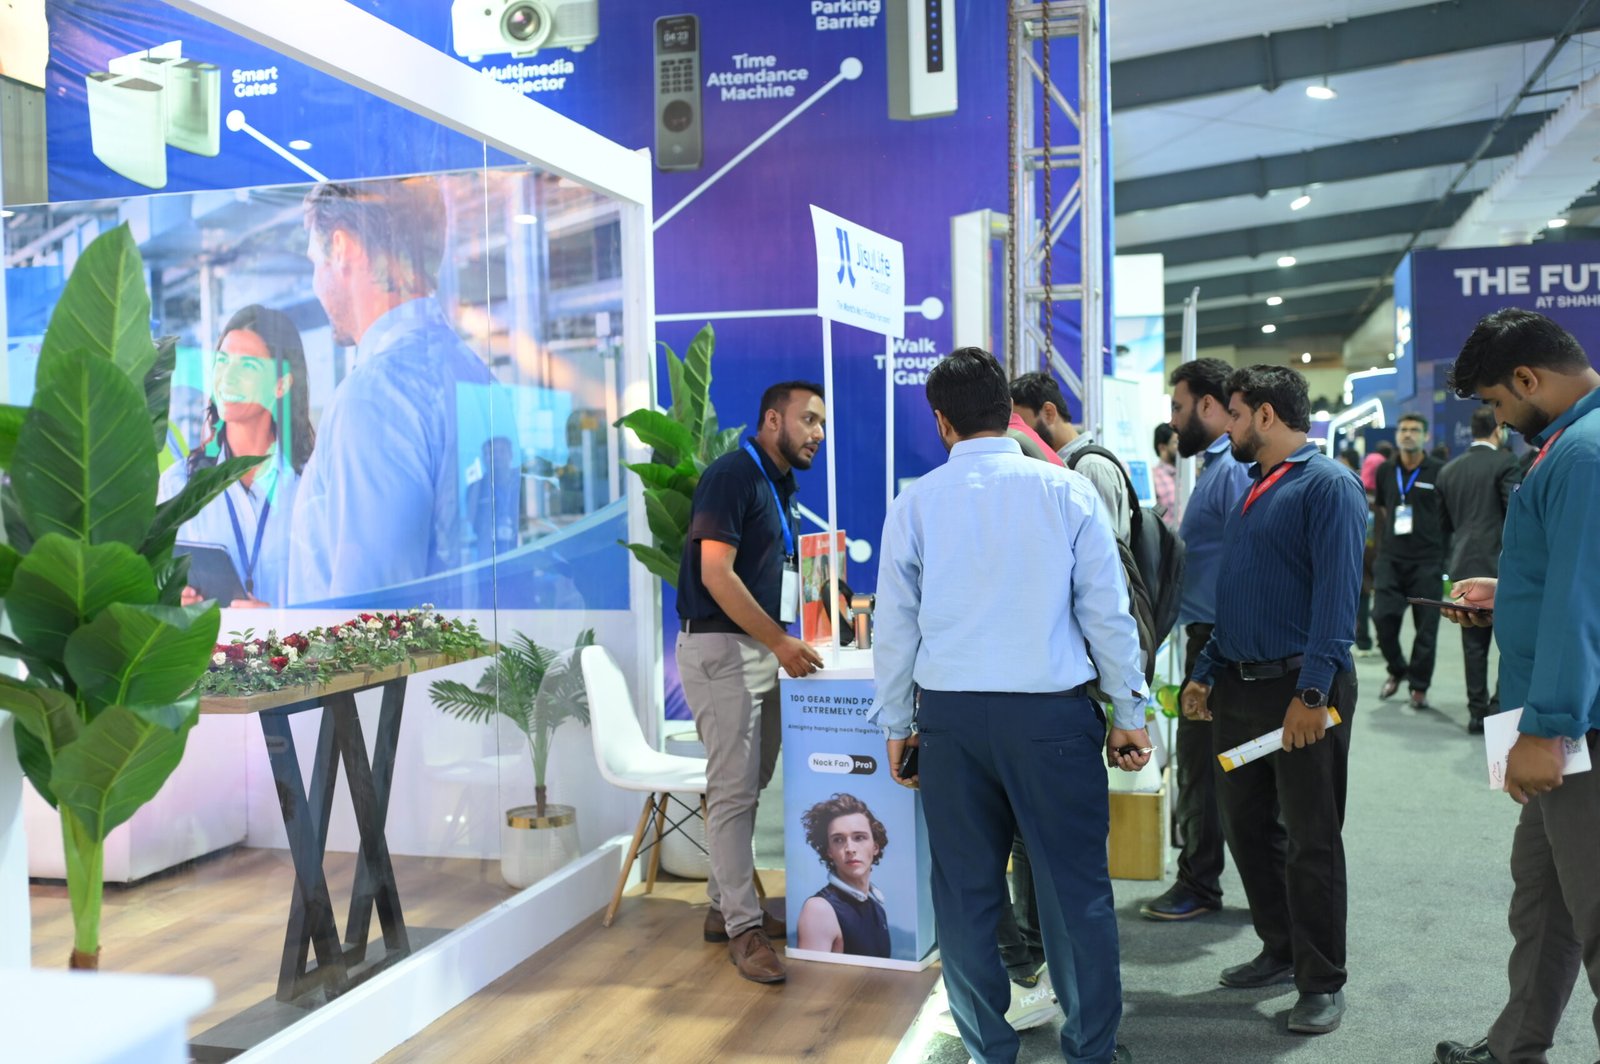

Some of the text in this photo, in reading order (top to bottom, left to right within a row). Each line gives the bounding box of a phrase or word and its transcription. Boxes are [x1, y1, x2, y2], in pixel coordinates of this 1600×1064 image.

[811, 0, 882, 15] Parking
[815, 13, 878, 31] Barrier
[481, 58, 574, 81] Multimedia
[732, 53, 777, 70] Time
[231, 66, 279, 84] Smart
[706, 68, 809, 87] Attendance
[234, 82, 278, 98] Gates
[497, 77, 567, 94] ojector
[721, 84, 796, 101] Machine
[1453, 266, 1531, 297] THE
[1535, 295, 1555, 309] AT
[893, 337, 937, 354] Walk
[873, 353, 945, 371] Troug
[894, 370, 929, 385] Gat
[790, 694, 805, 702] 100
[807, 695, 831, 704] GEAR
[834, 696, 859, 705] WIND
[802, 705, 853, 715] EXTREMELY
[813, 758, 873, 769] Neck Fan Pro1
[1020, 988, 1049, 1008] HOKA
